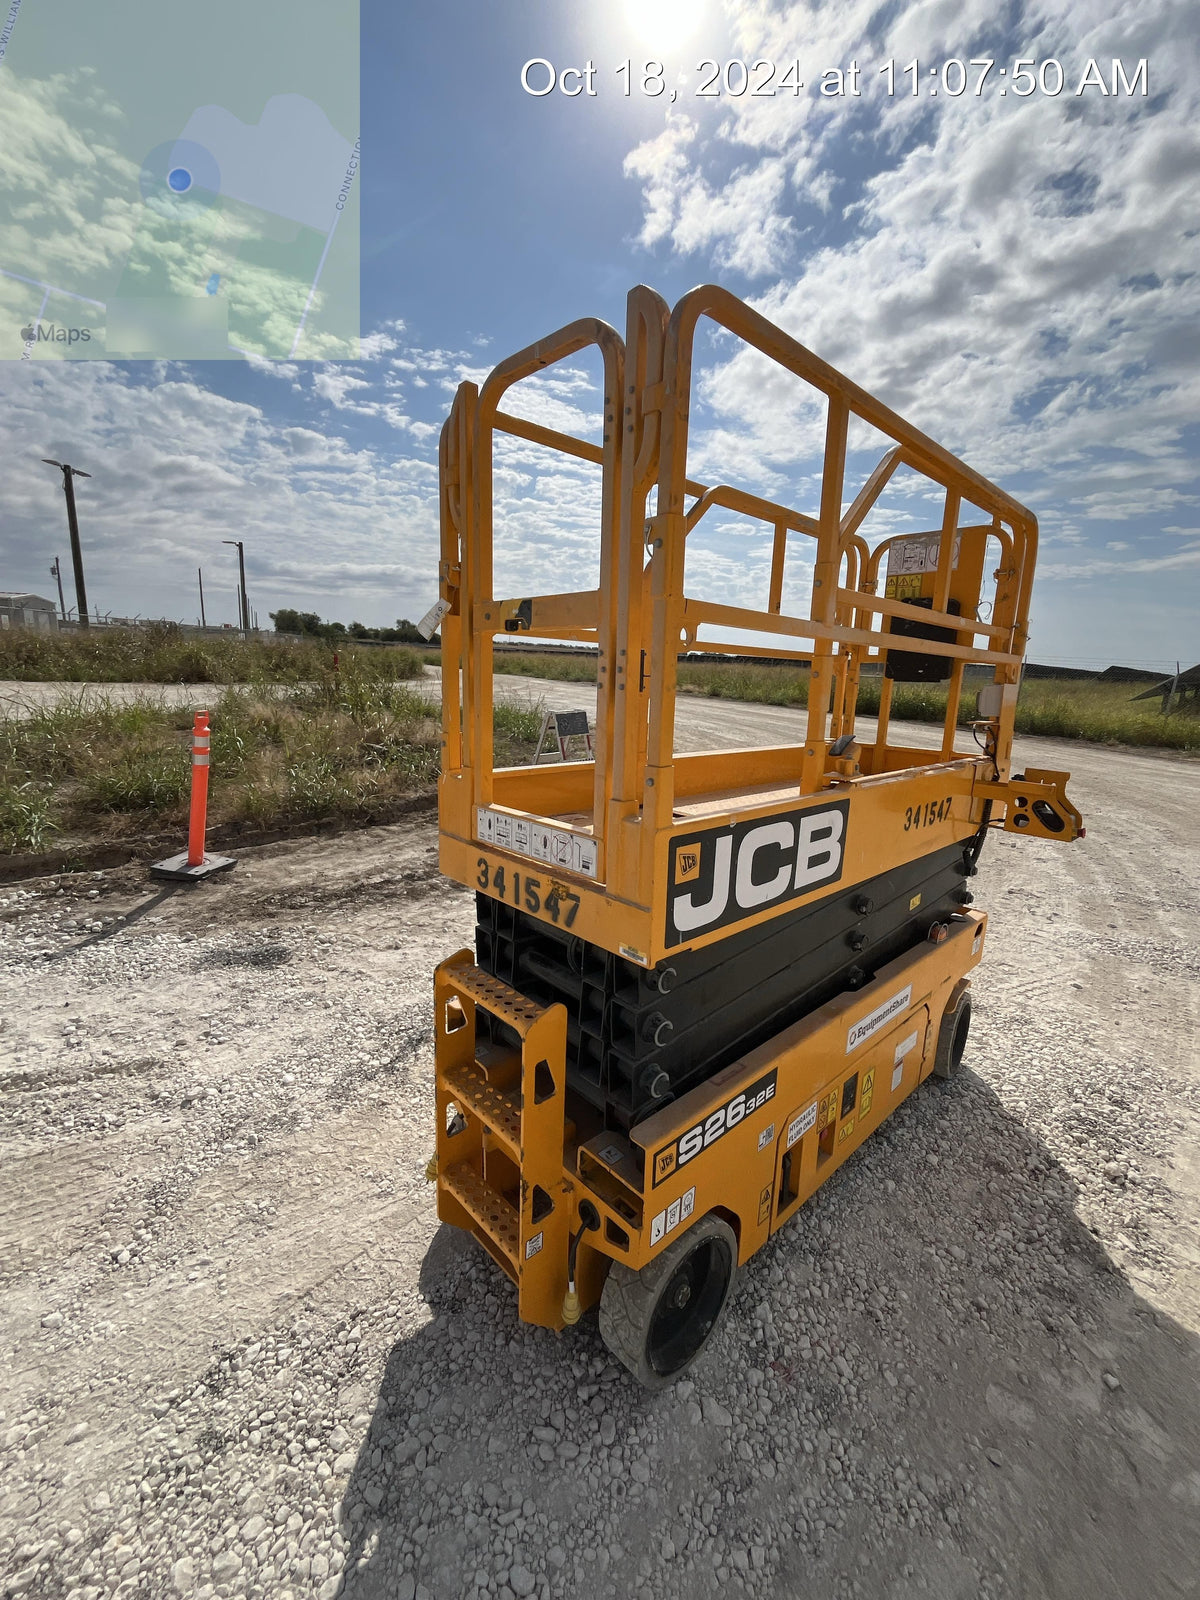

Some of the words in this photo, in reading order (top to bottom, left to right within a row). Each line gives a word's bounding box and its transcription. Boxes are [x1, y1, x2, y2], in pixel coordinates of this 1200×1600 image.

[904, 797, 953, 831] 341547
[673, 809, 844, 932] JCB
[680, 853, 697, 874] JCB
[476, 857, 581, 928] 341547
[857, 994, 909, 1040] EquipmentShare
